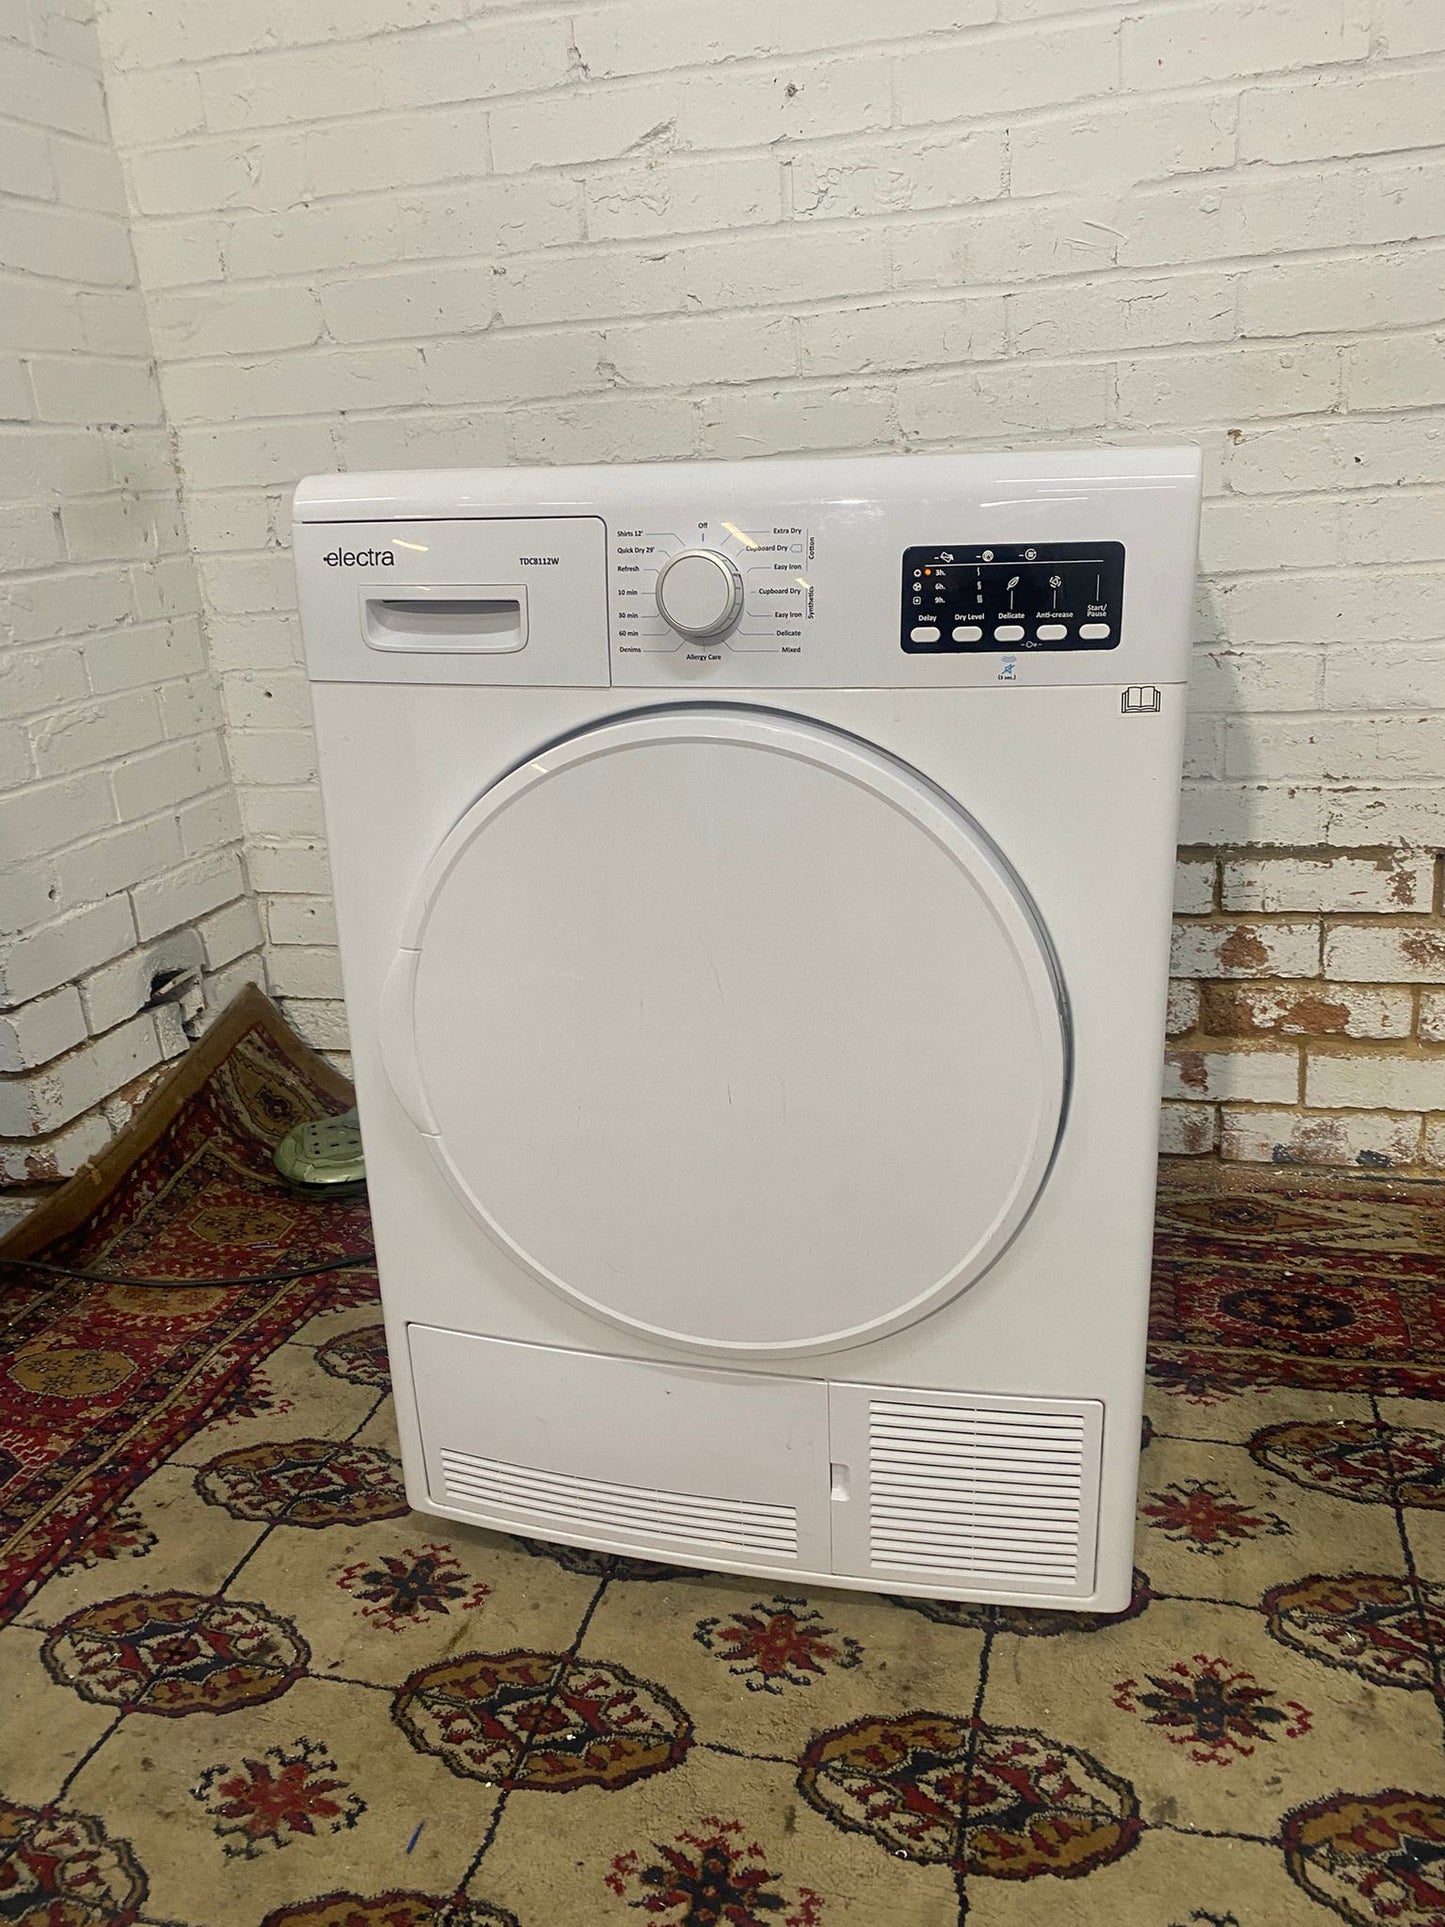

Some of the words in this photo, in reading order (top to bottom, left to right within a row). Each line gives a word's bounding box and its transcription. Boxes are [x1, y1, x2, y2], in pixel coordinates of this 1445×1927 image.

[790, 527, 802, 535] Dry
[634, 547, 645, 555] Dry
[323, 547, 394, 567] electra
[520, 557, 560, 566] TDC8112W
[774, 564, 787, 572] Easy
[807, 586, 815, 619] Synthetics
[934, 596, 946, 604] 9h.
[1087, 604, 1107, 612] Start/
[968, 613, 985, 621] Level
[998, 612, 1025, 620] Delicate
[1036, 611, 1073, 619] Anti-crease
[1087, 610, 1107, 618] Pause
[918, 614, 937, 623] Delay
[686, 654, 706, 662] Allergy
